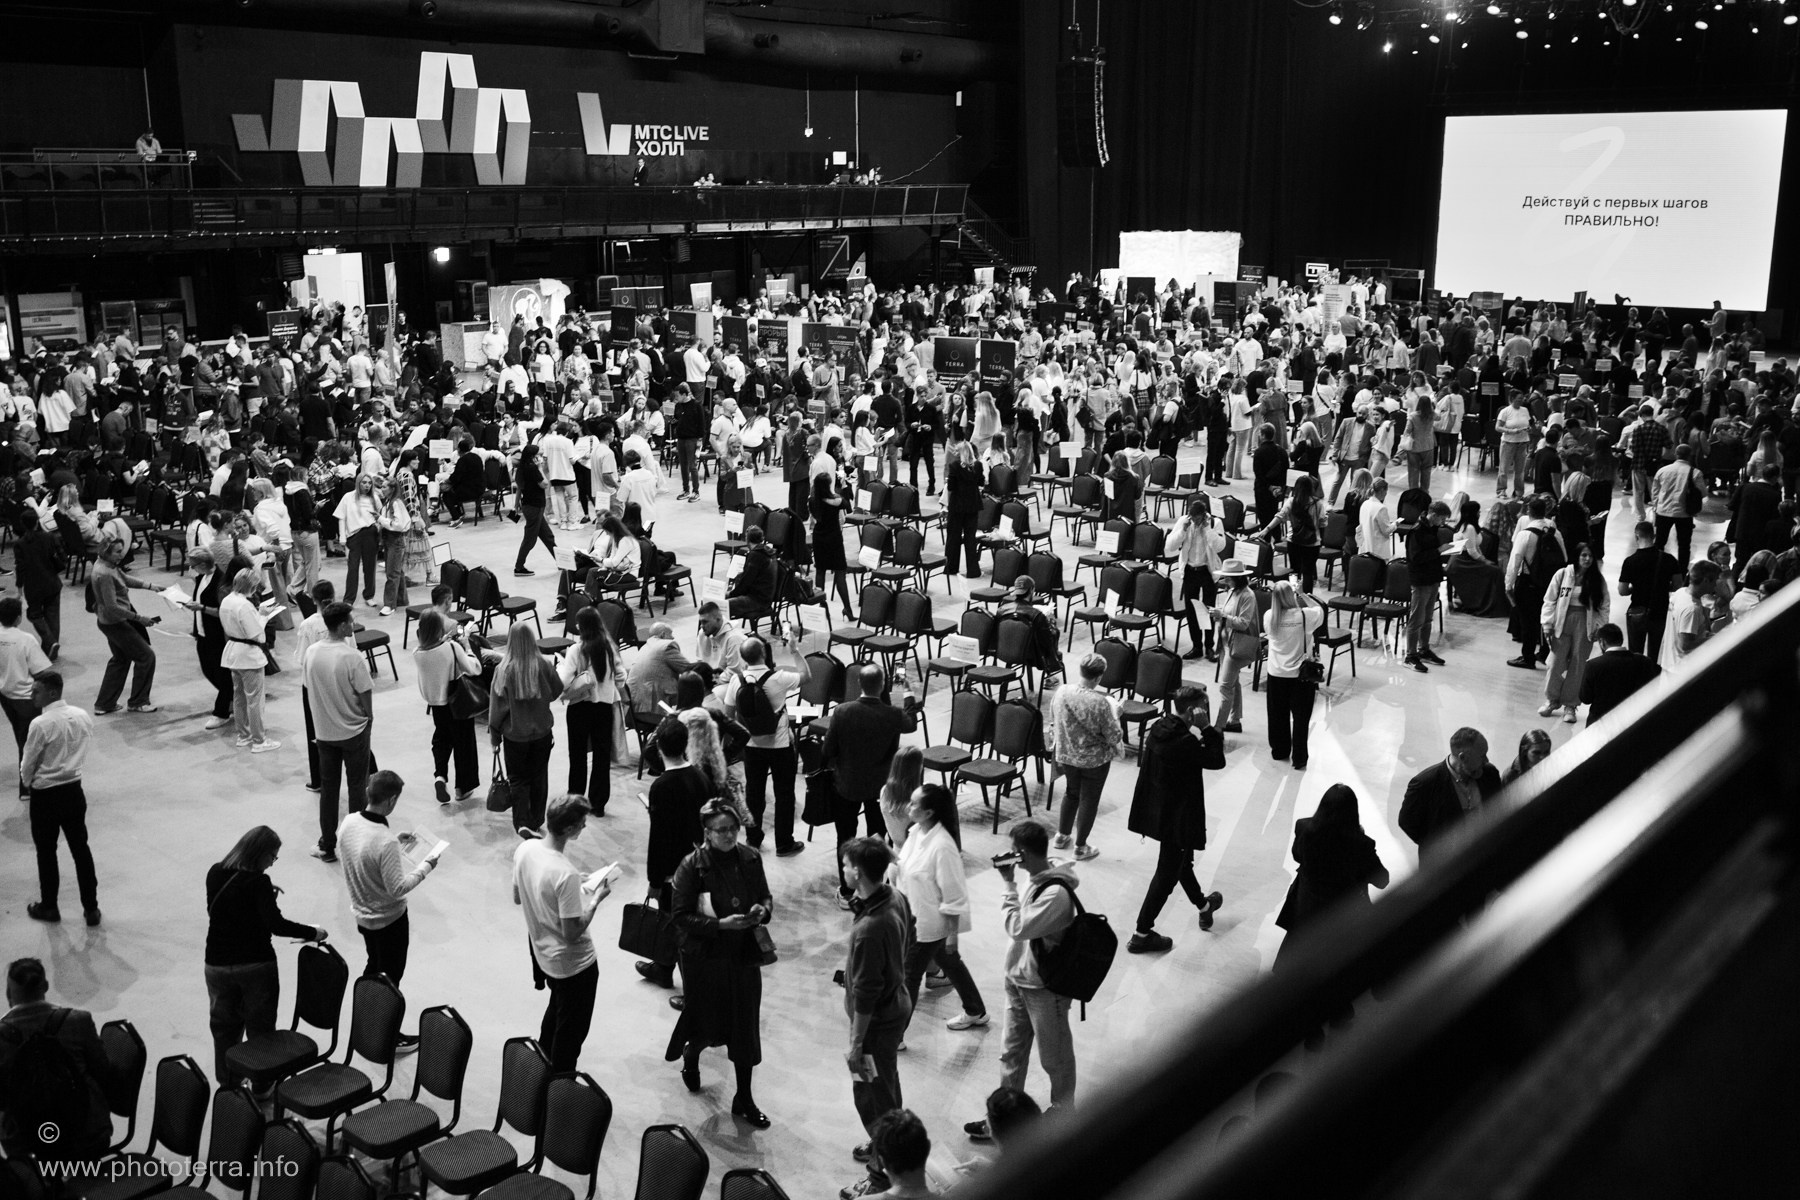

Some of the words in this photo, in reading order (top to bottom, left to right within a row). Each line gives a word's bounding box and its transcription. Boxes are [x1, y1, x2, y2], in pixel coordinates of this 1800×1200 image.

[635, 125, 673, 140] МТС
[674, 126, 709, 140] LIVE
[636, 141, 684, 156] ХОЛЛ
[1522, 196, 1589, 210] Действуй
[1593, 199, 1601, 208] с
[1605, 199, 1659, 210] первых
[1663, 199, 1709, 209] шагов
[1564, 215, 1659, 227] ПРАВИЛЬНО!
[759, 329, 788, 338] ПРОРЫВ
